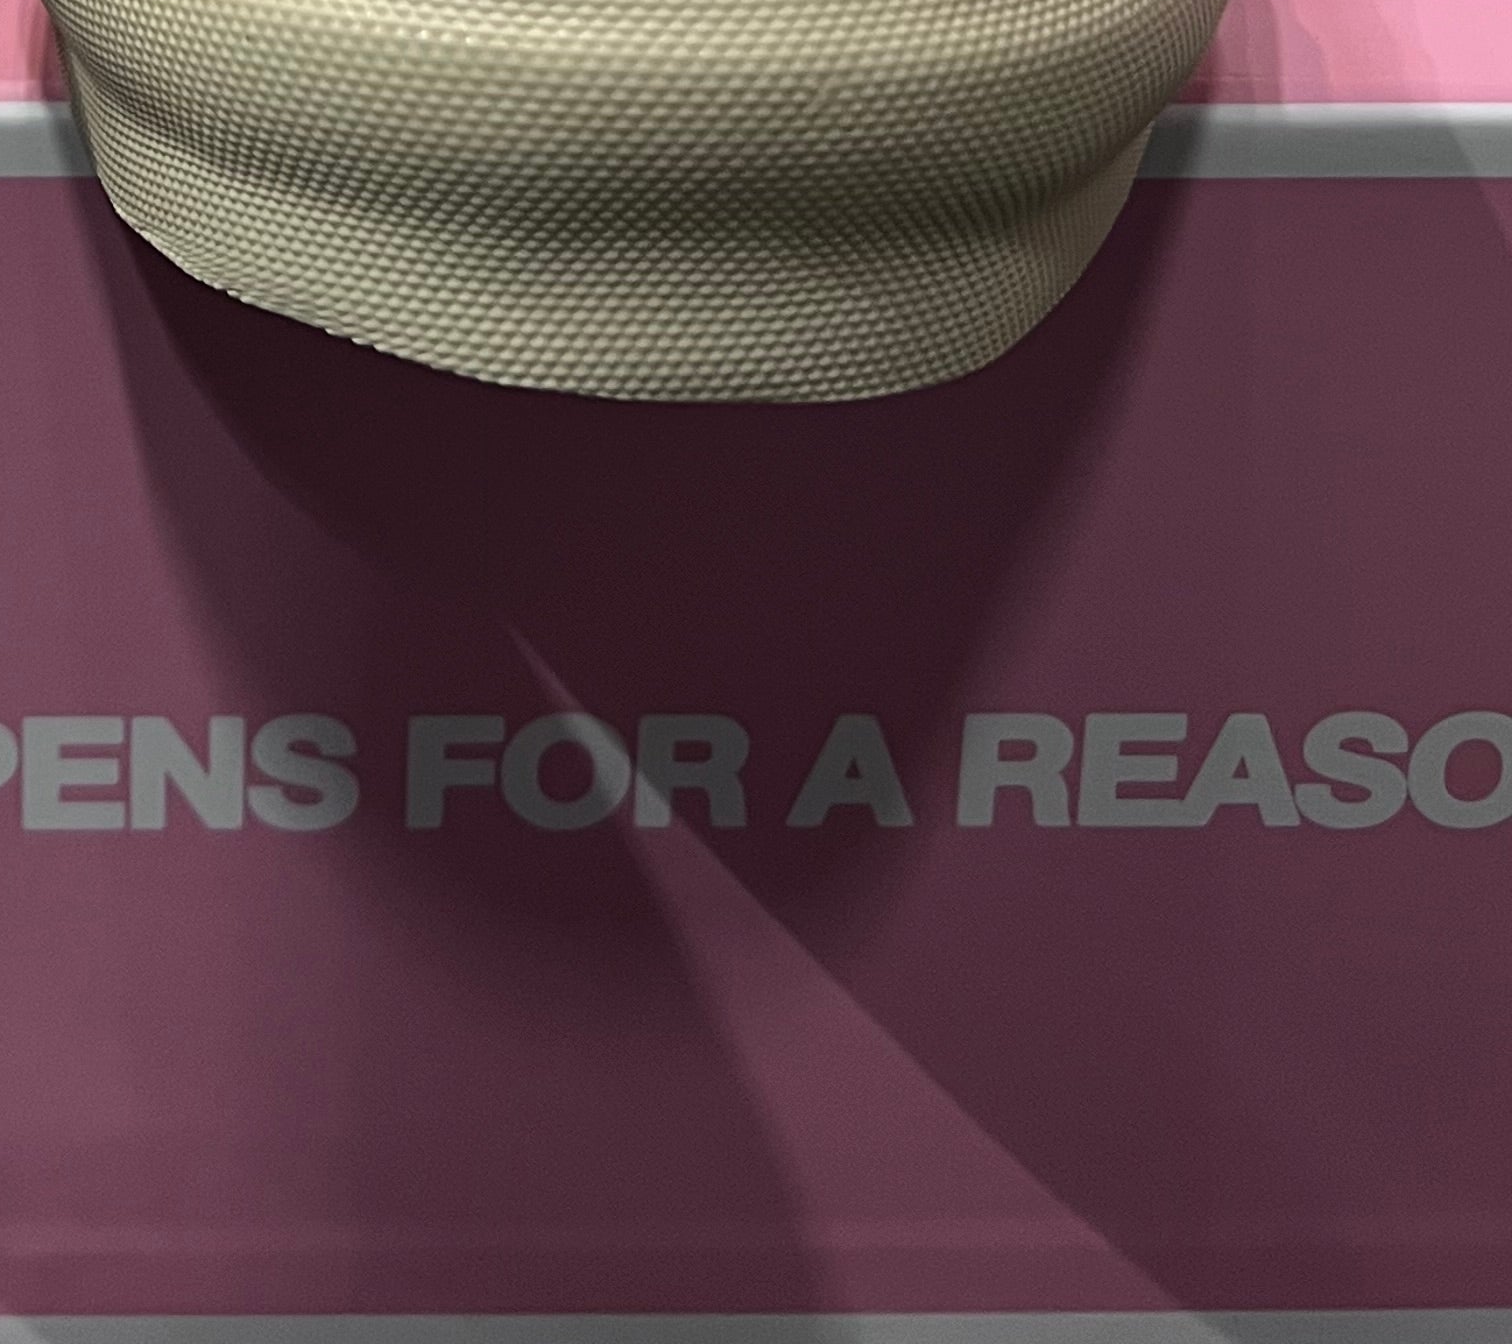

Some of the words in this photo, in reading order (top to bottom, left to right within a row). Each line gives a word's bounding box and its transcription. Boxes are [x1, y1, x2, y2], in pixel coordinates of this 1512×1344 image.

[406, 712, 750, 829] FOR
[788, 714, 914, 827] A
[956, 711, 1512, 829] REASO
